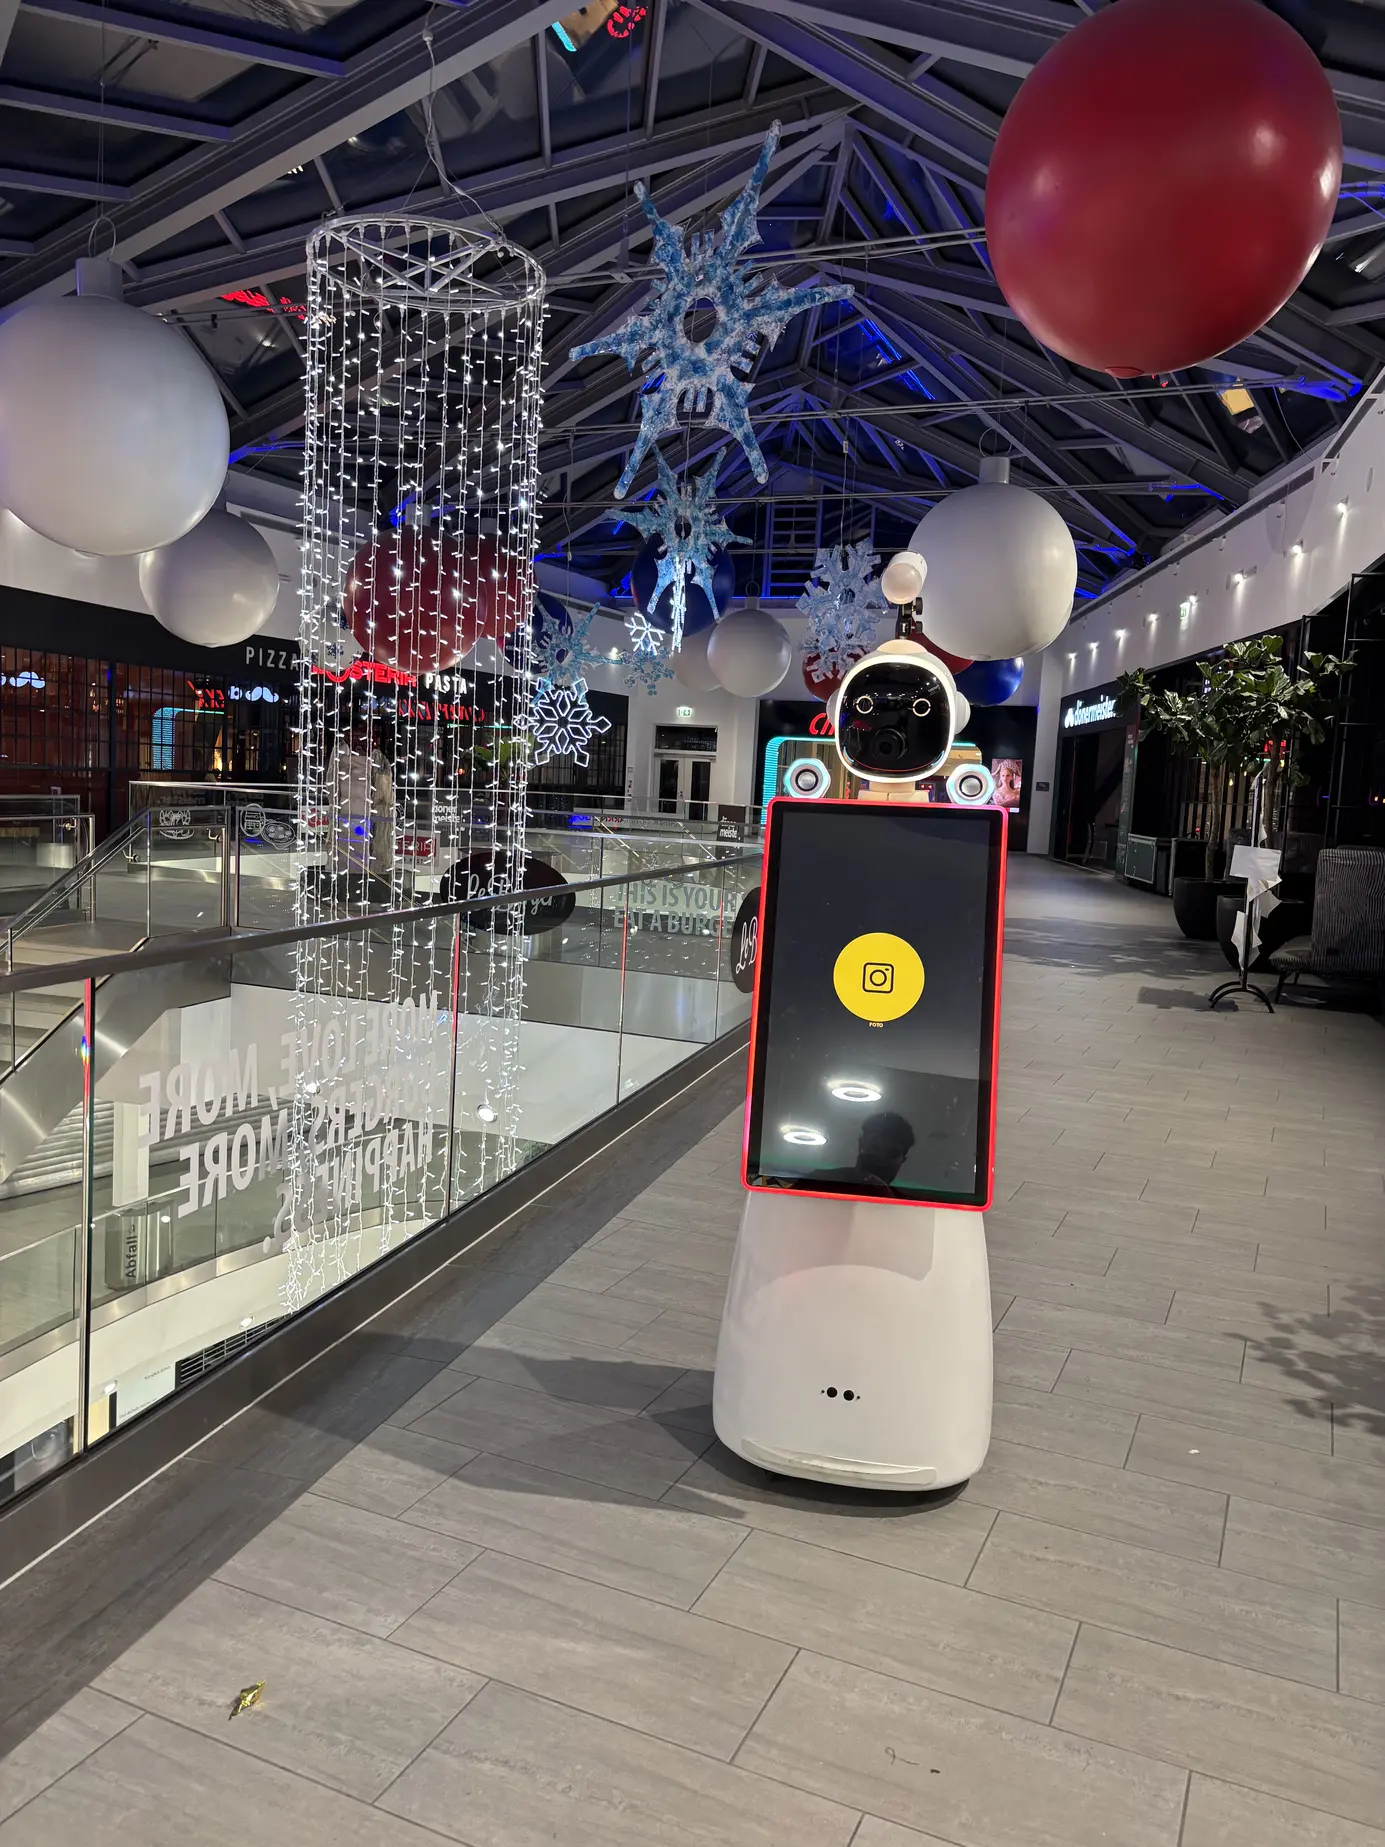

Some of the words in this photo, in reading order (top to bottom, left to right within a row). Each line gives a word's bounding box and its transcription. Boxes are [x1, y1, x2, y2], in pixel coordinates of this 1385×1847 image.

[245, 646, 299, 671] PIZZA
[424, 672, 468, 694] PASTA
[619, 881, 657, 905] THIS
[662, 884, 679, 907] IS
[683, 886, 736, 913] YOUR
[614, 905, 646, 930] EAT
[650, 909, 662, 931] A
[667, 910, 734, 939] BURGE
[125, 1235, 137, 1279] Abfall
